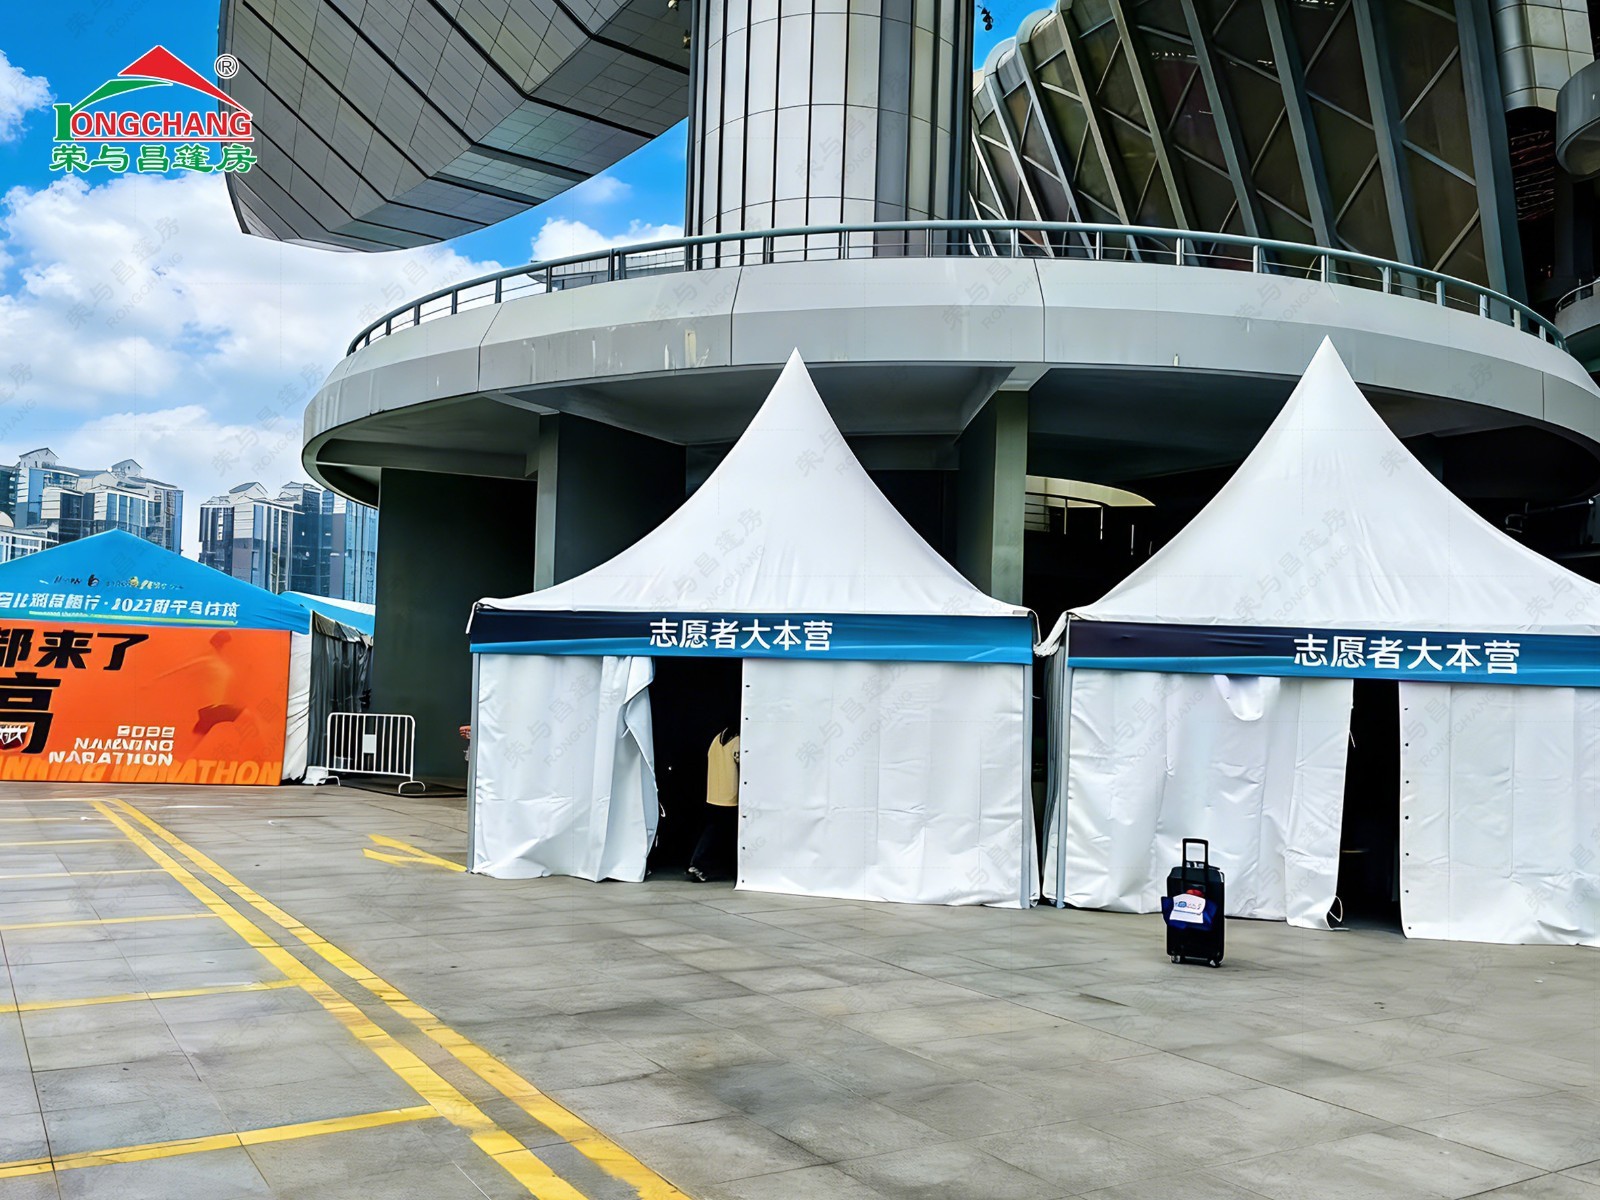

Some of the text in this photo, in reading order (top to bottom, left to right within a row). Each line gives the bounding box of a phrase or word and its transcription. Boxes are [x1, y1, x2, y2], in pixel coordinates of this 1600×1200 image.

[649, 617, 834, 651] 志愿者大本营
[1293, 633, 1521, 675] 志愿者大本营
